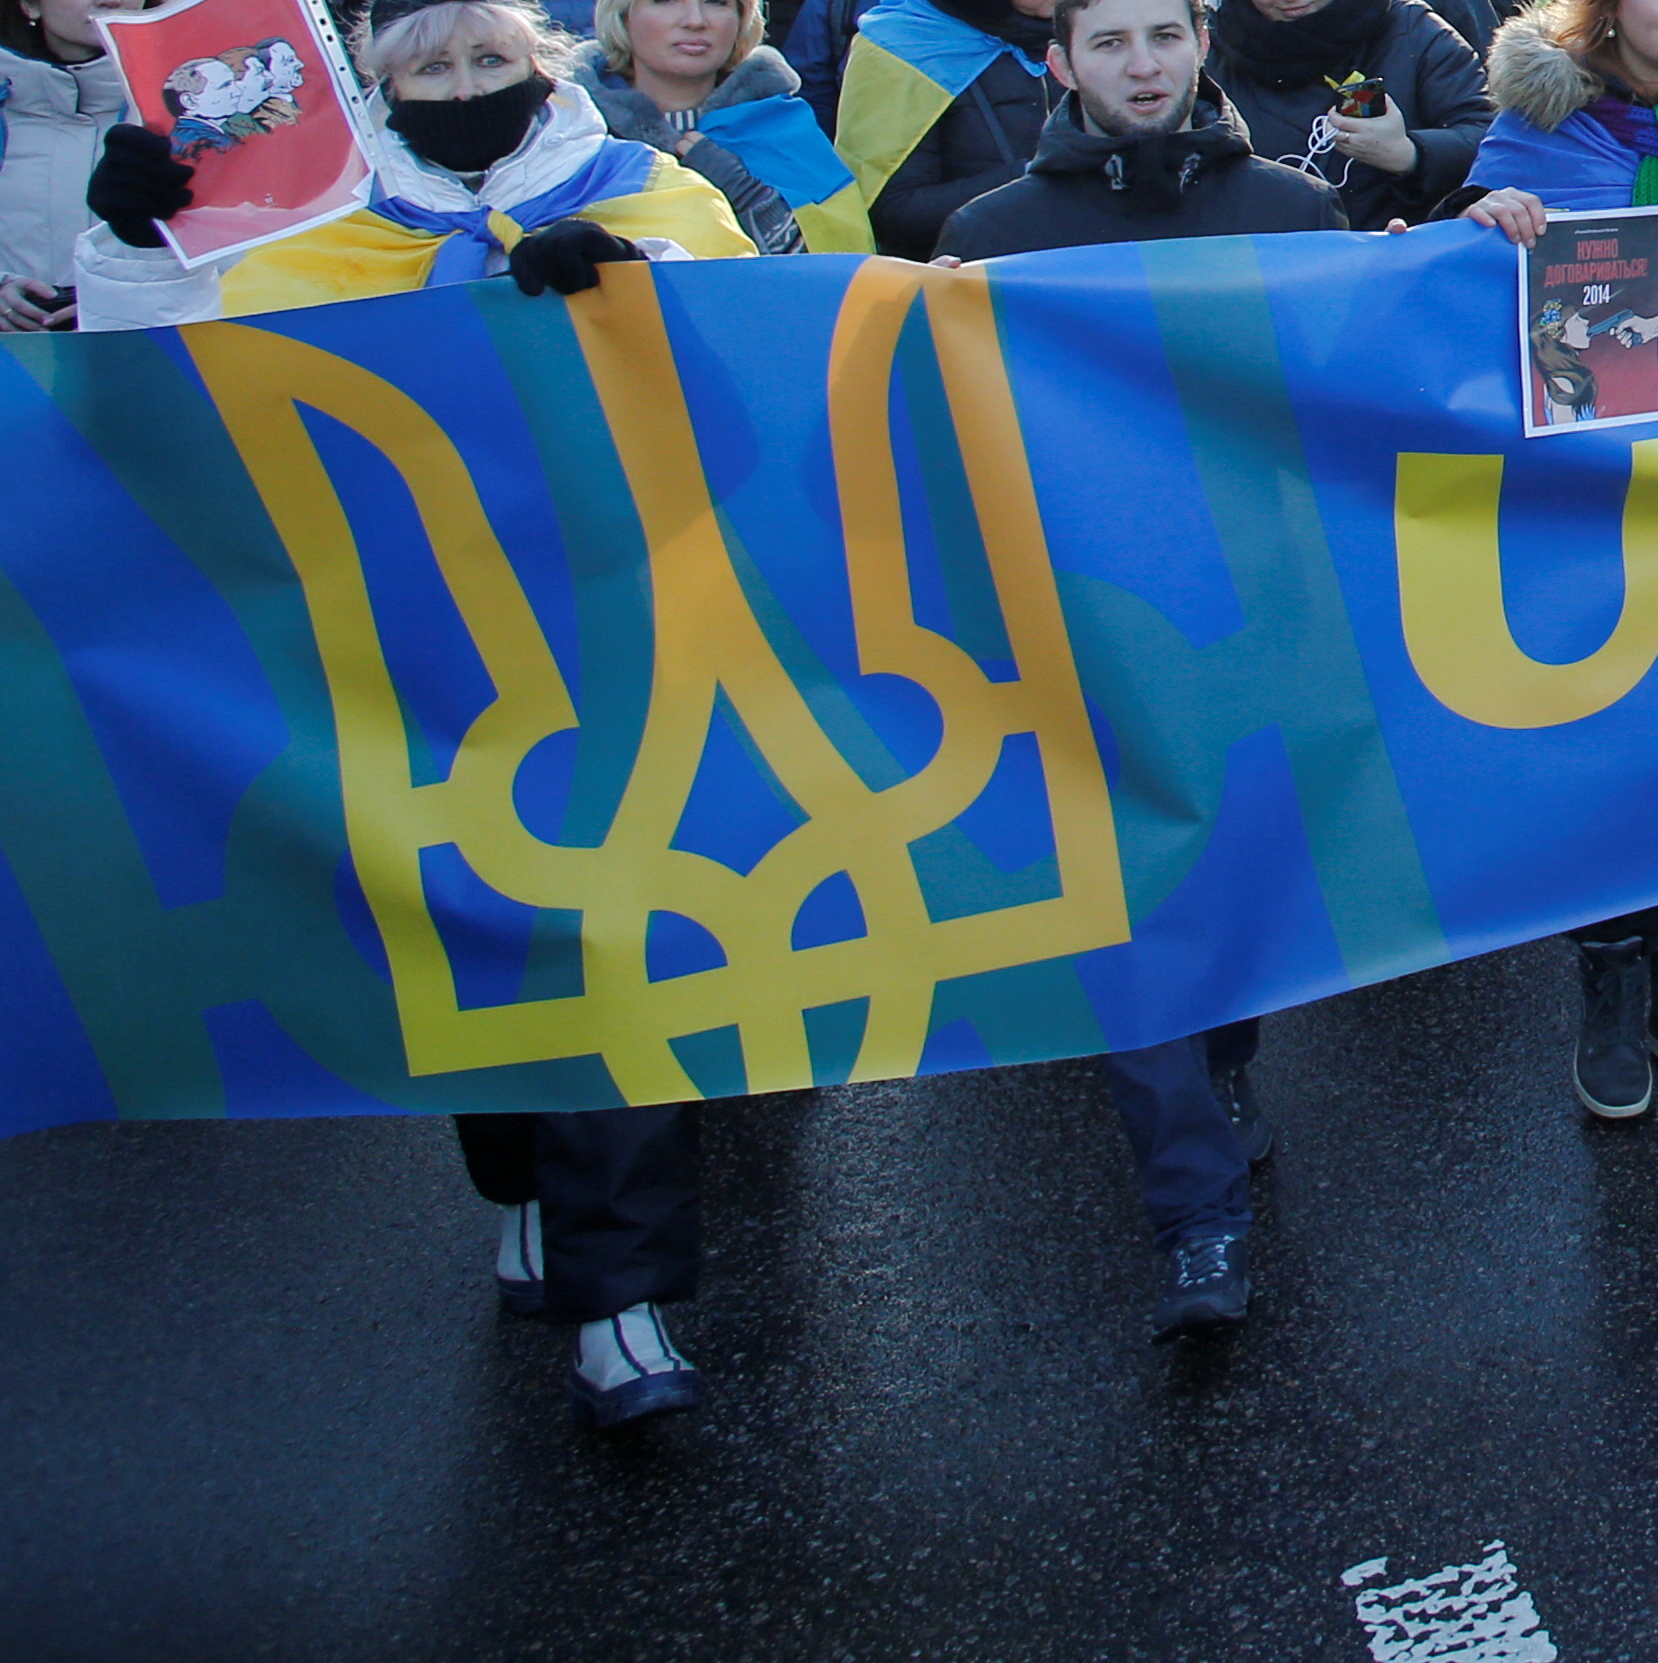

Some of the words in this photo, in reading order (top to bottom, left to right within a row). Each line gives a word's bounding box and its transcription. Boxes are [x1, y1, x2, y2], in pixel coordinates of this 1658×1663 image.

[1577, 238, 1619, 261] НУЖНО
[1544, 258, 1649, 288] ДОГОВАРИВАТЬСЯ!
[1583, 283, 1611, 306] 2014
